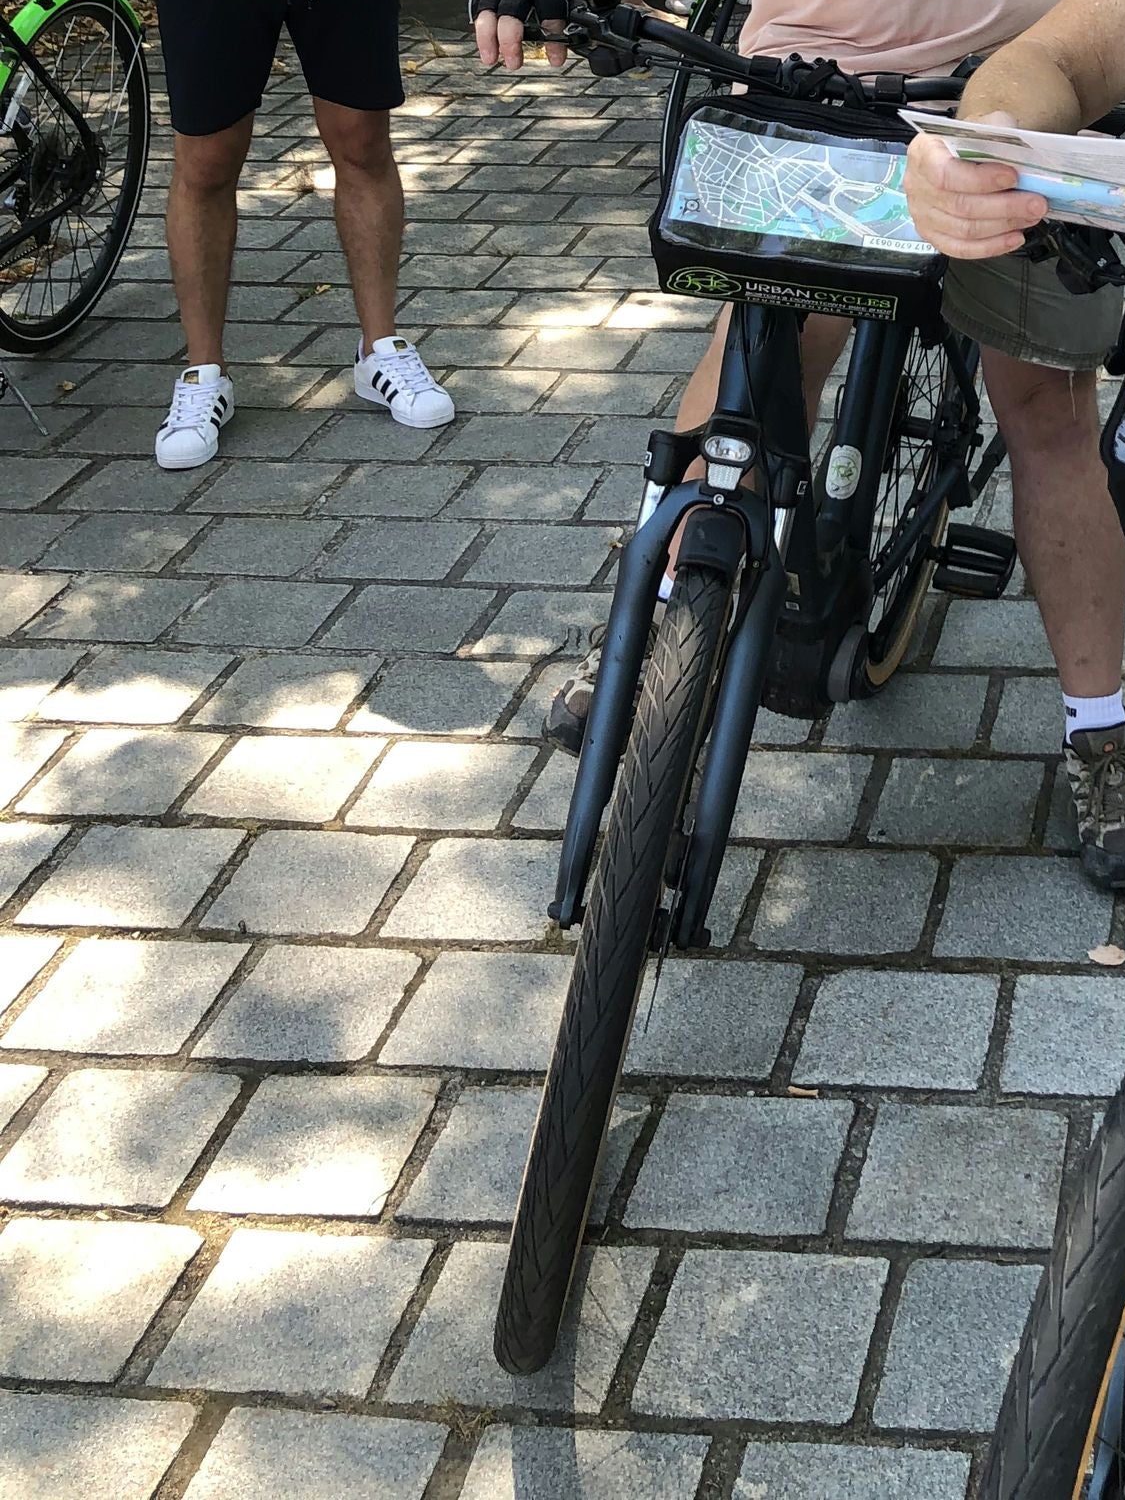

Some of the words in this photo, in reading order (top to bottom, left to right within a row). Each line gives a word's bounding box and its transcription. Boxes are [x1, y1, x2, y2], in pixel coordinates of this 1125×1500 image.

[870, 238, 892, 247] 0637
[895, 241, 912, 249] 670
[745, 281, 810, 299] URBAN
[814, 291, 891, 308] CYCLES
